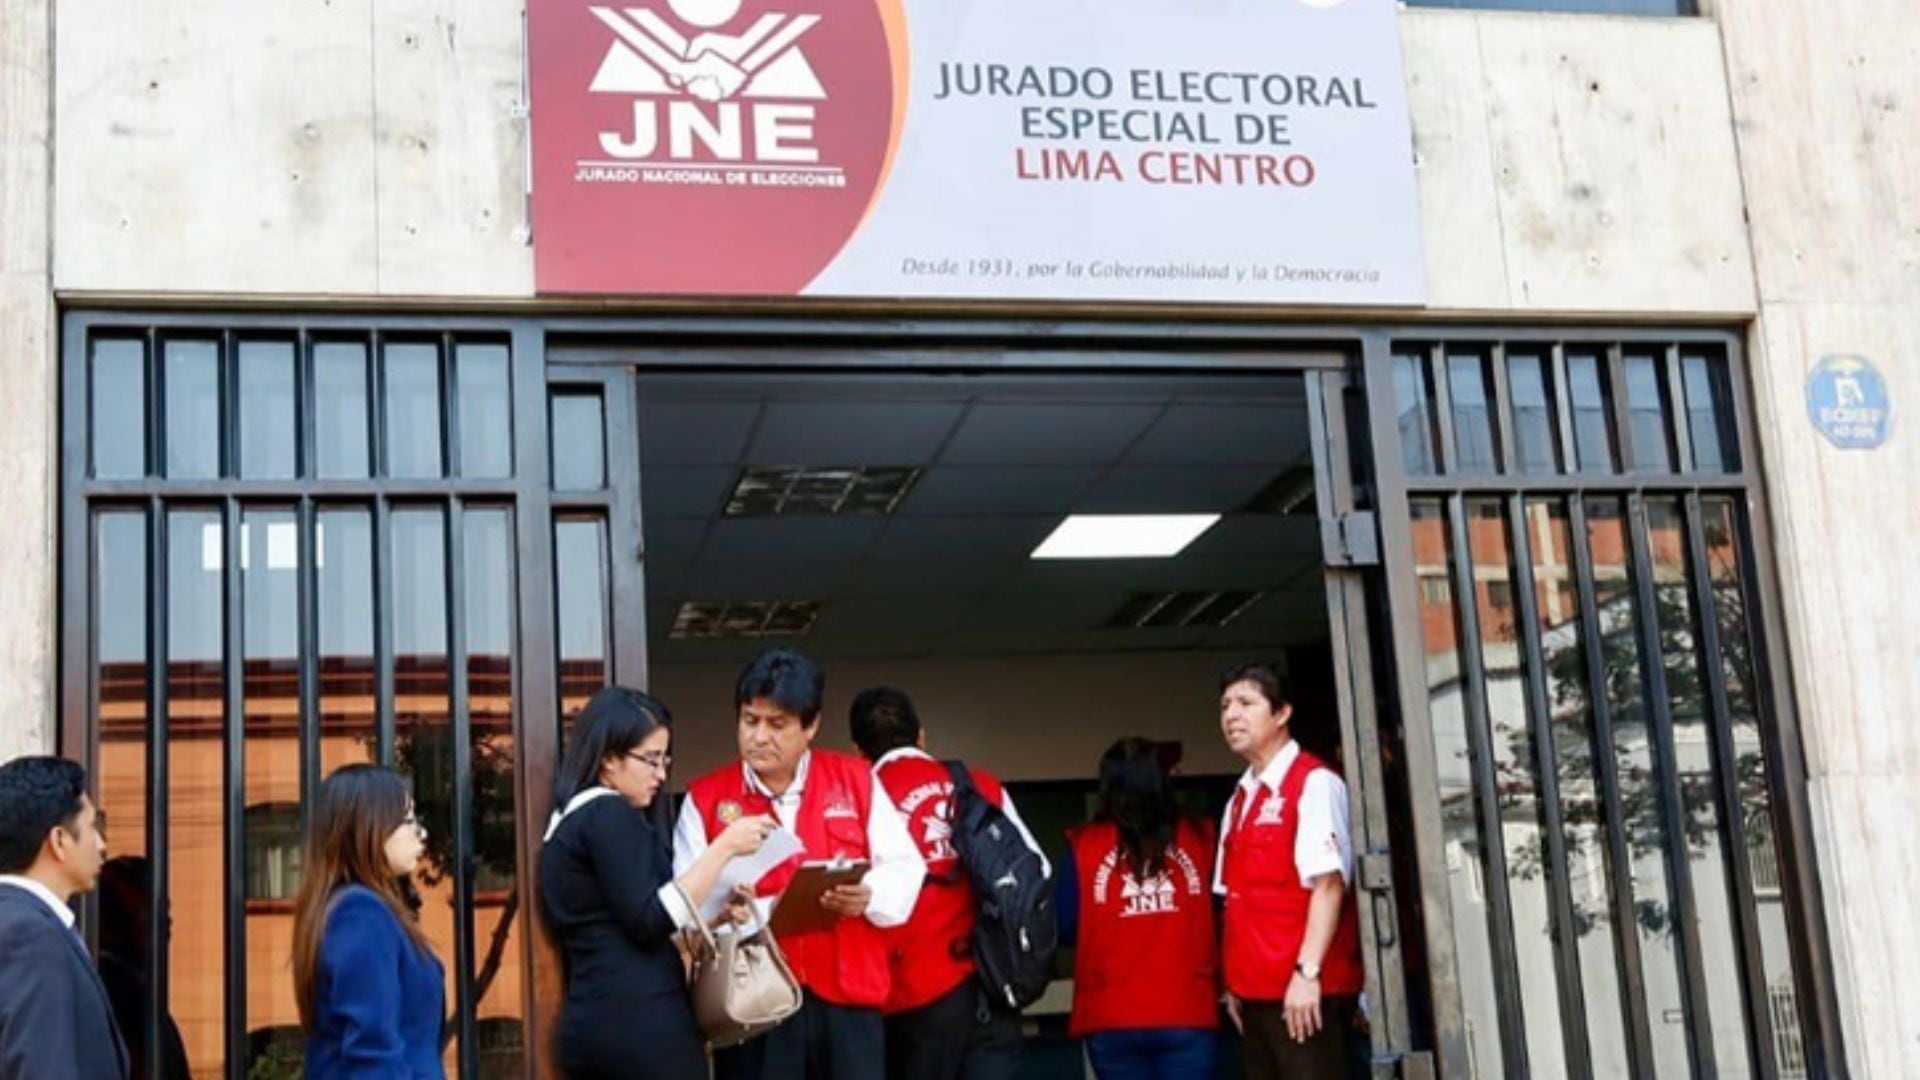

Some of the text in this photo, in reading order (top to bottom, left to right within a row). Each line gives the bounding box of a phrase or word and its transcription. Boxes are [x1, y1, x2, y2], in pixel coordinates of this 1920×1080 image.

[934, 62, 1377, 109] JURADO ELECTORAL
[598, 99, 820, 162] JNE
[1020, 106, 1292, 145] ESPECIAL DE
[575, 168, 847, 188] JURADO NACIONAL DE ELECCIONES
[1015, 147, 1316, 187] LIMA CENTRO
[901, 257, 960, 277] Desde
[967, 258, 1021, 278] 1931,
[1026, 260, 1059, 280] por
[1065, 260, 1083, 278] la
[1088, 260, 1230, 281] Gobernabilidad
[1251, 264, 1268, 282] la
[1273, 264, 1381, 285] Democracia
[1124, 893, 1175, 913] JNE
